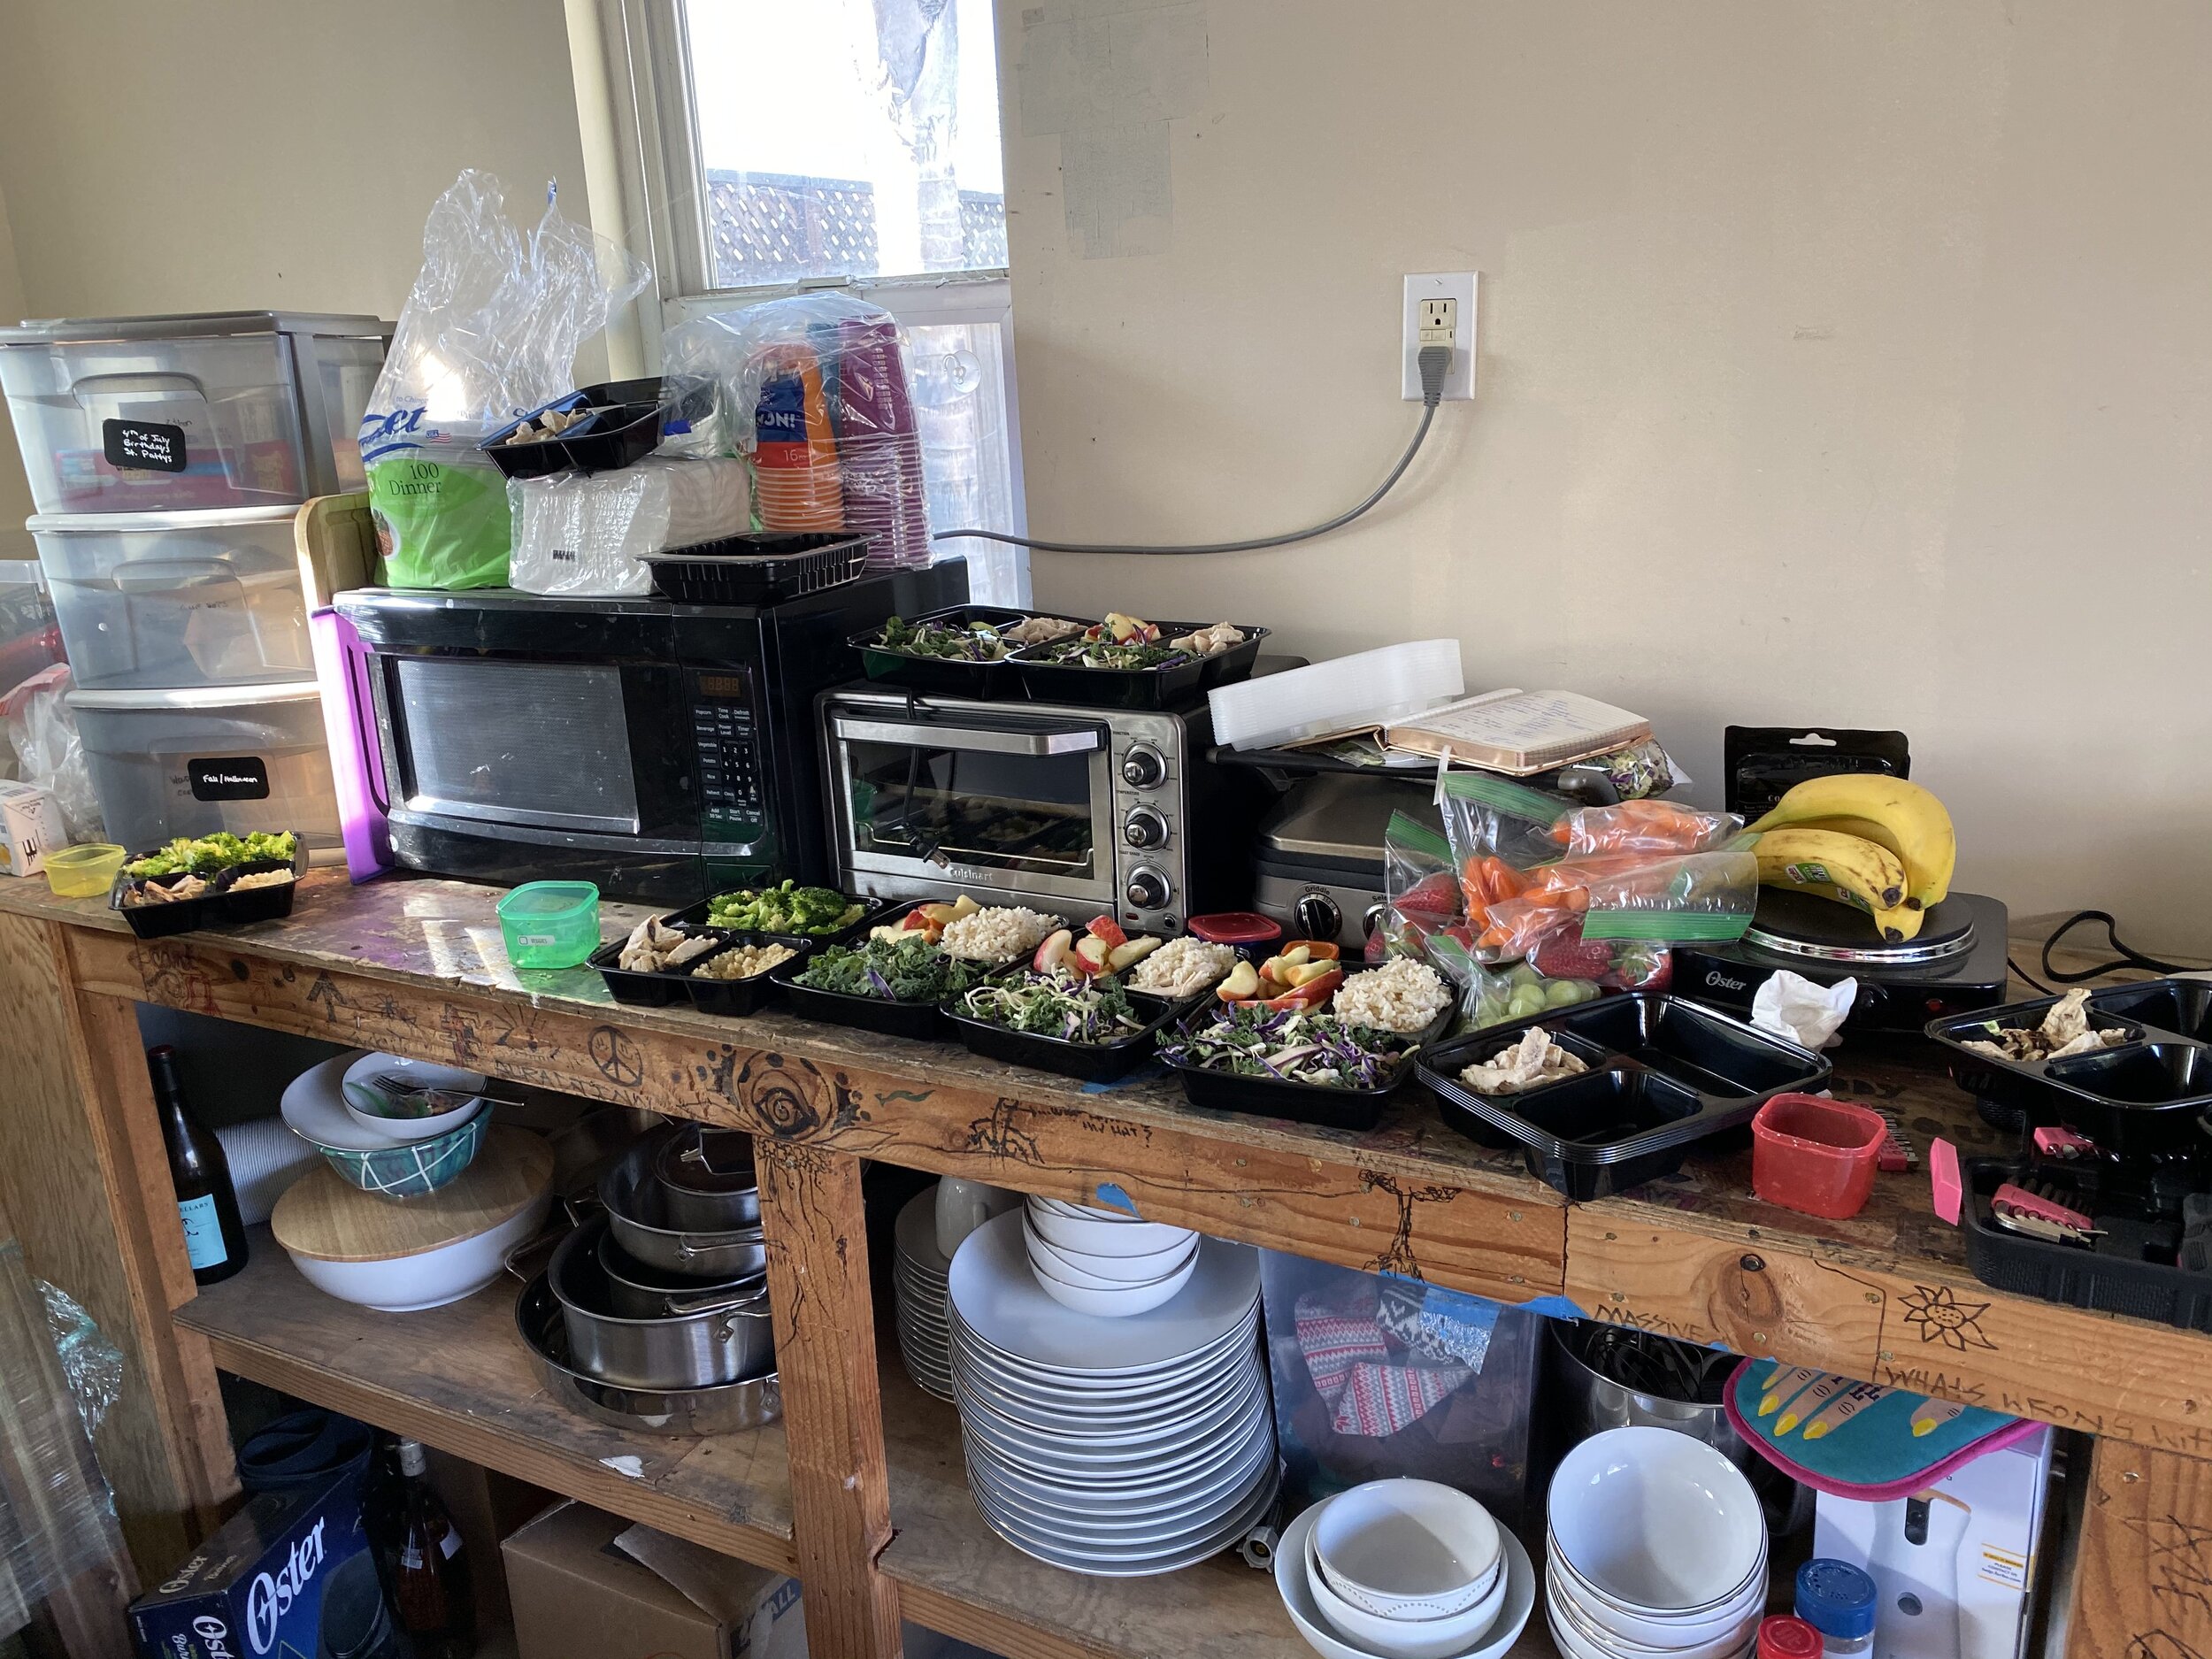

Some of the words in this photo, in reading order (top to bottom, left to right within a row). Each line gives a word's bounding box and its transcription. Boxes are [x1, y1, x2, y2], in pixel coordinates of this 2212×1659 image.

[123, 438, 171, 455] Birthdays
[150, 434, 171, 448] July
[410, 462, 441, 480] 100
[388, 479, 442, 496] Dinner
[1304, 886, 1331, 895] Griddle
[1705, 971, 1747, 990] Oster
[247, 1516, 326, 1655] Oster
